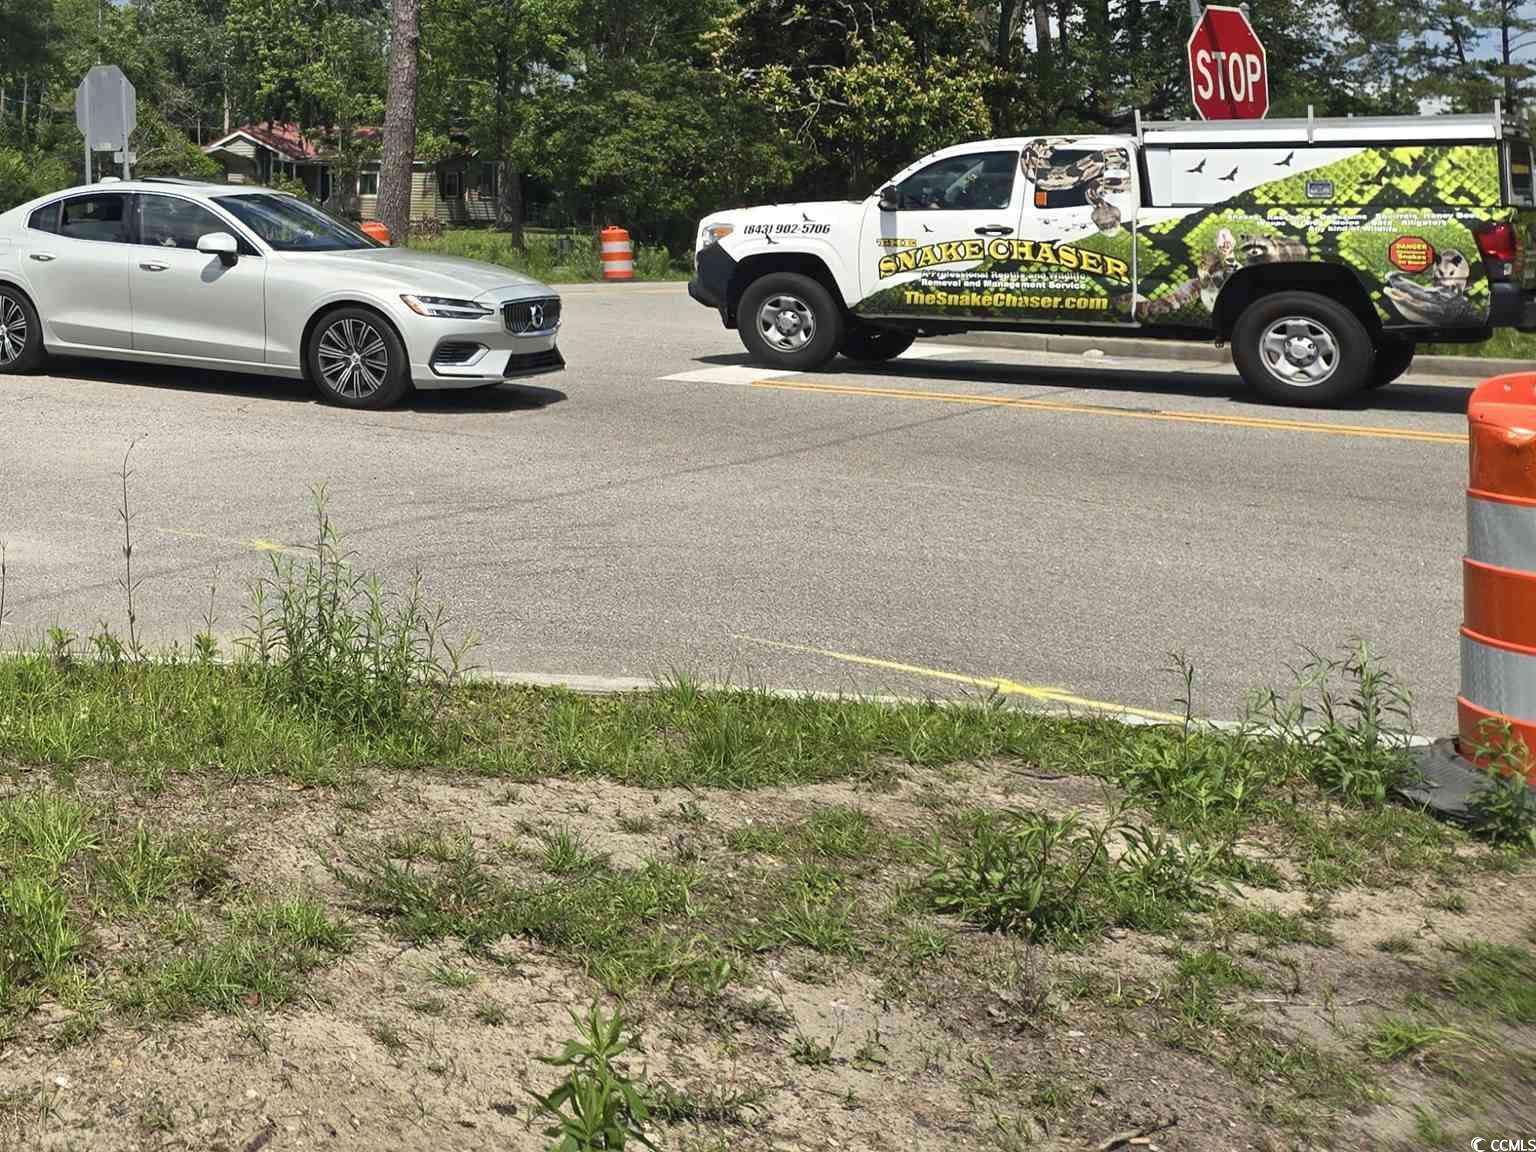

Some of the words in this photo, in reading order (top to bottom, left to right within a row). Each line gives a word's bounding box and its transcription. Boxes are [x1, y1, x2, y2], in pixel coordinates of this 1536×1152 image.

[1196, 49, 1262, 103] STOP
[743, 223, 774, 235] (843)
[774, 223, 832, 235] 902-5706
[879, 238, 985, 279] SNAKE
[987, 236, 1131, 284] CHASER
[921, 278, 962, 287] Removal
[963, 279, 981, 288] and
[983, 279, 1047, 290] Management
[1049, 280, 1087, 290] Service
[904, 290, 1109, 311] TheSnakeChaser.com
